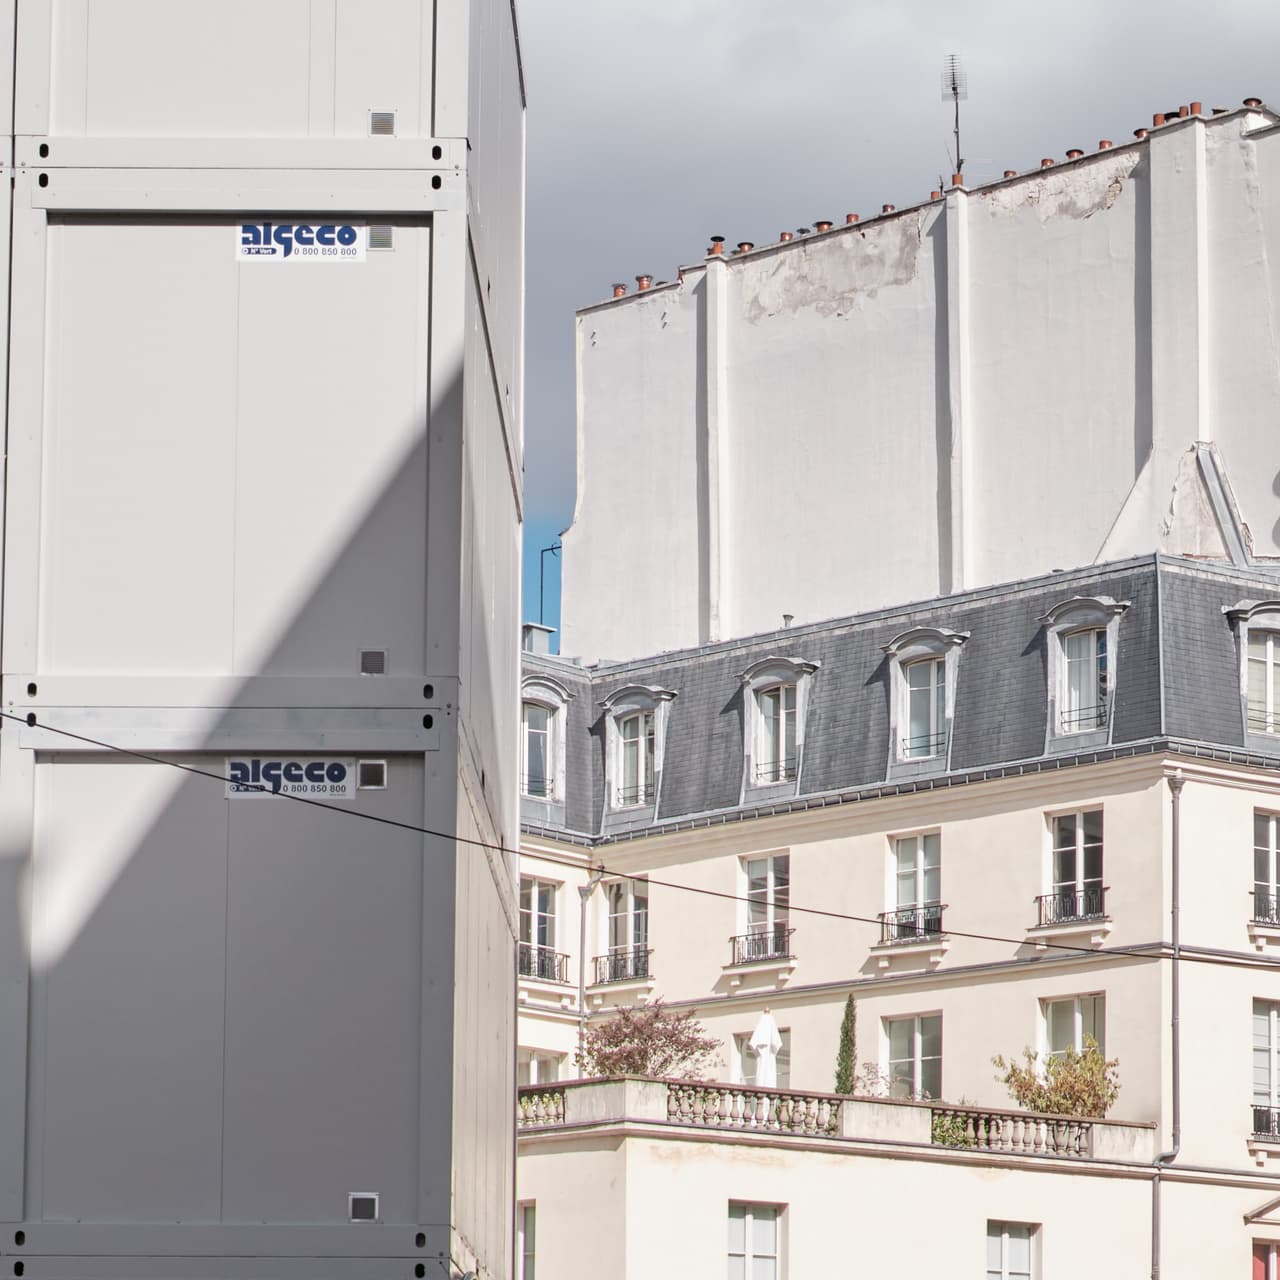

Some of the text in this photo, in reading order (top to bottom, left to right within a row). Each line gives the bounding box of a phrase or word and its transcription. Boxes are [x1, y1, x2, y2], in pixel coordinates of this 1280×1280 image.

[241, 223, 357, 257] algeco
[230, 759, 346, 794] algeco
[283, 785, 288, 793] 0
[291, 785, 308, 793] 800
[311, 785, 327, 793] 850
[330, 785, 346, 793] 800
